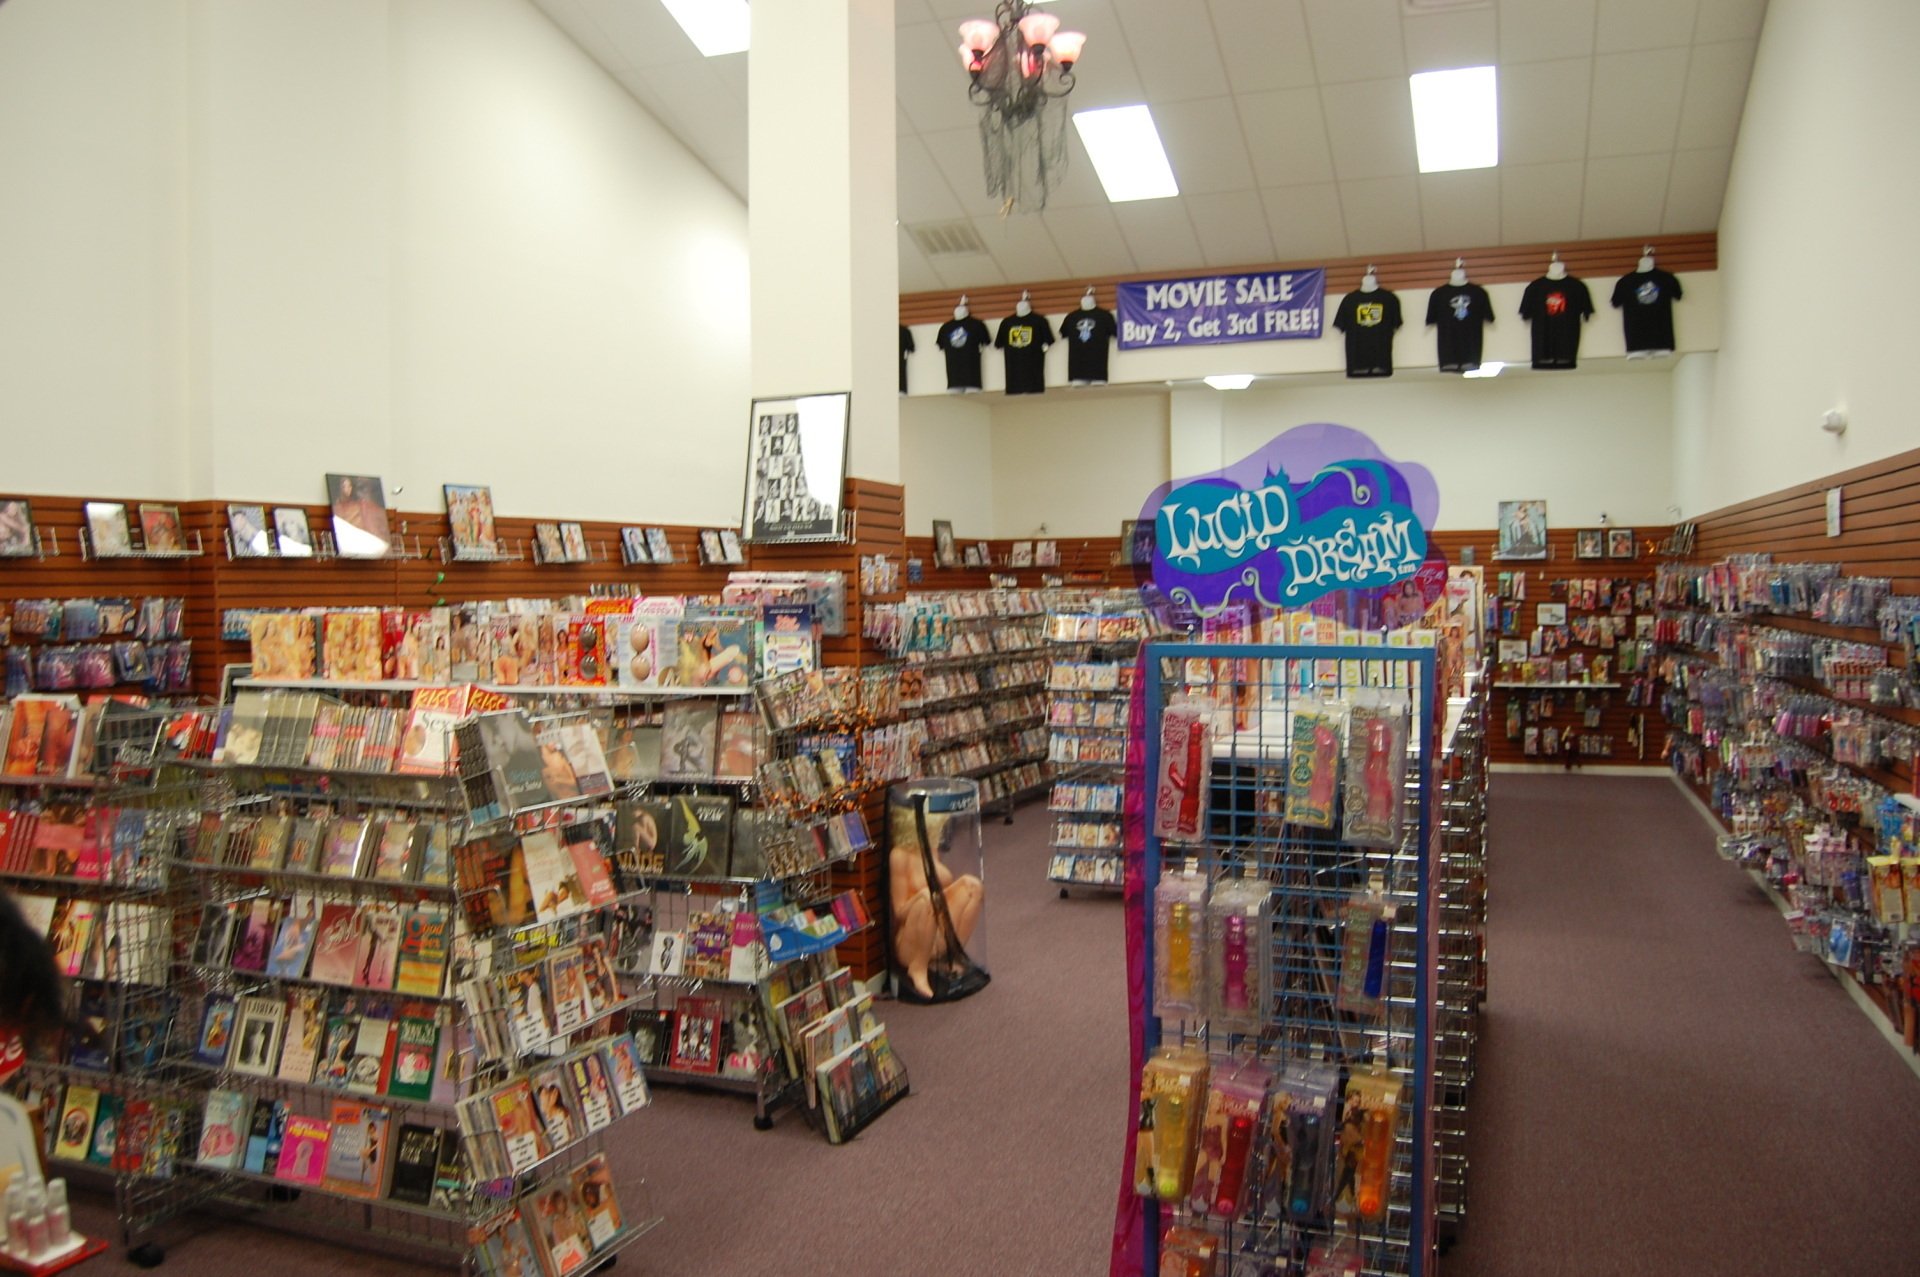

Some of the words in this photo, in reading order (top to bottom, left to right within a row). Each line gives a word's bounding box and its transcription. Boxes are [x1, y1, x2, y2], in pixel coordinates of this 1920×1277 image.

[1145, 278, 1228, 311] MOVIE
[1236, 275, 1293, 305] SALE
[1122, 320, 1157, 345] Buy
[1163, 318, 1182, 343] 2,
[1187, 316, 1221, 339] Get
[1227, 311, 1257, 335] 3rd
[1264, 308, 1320, 334] FREE!
